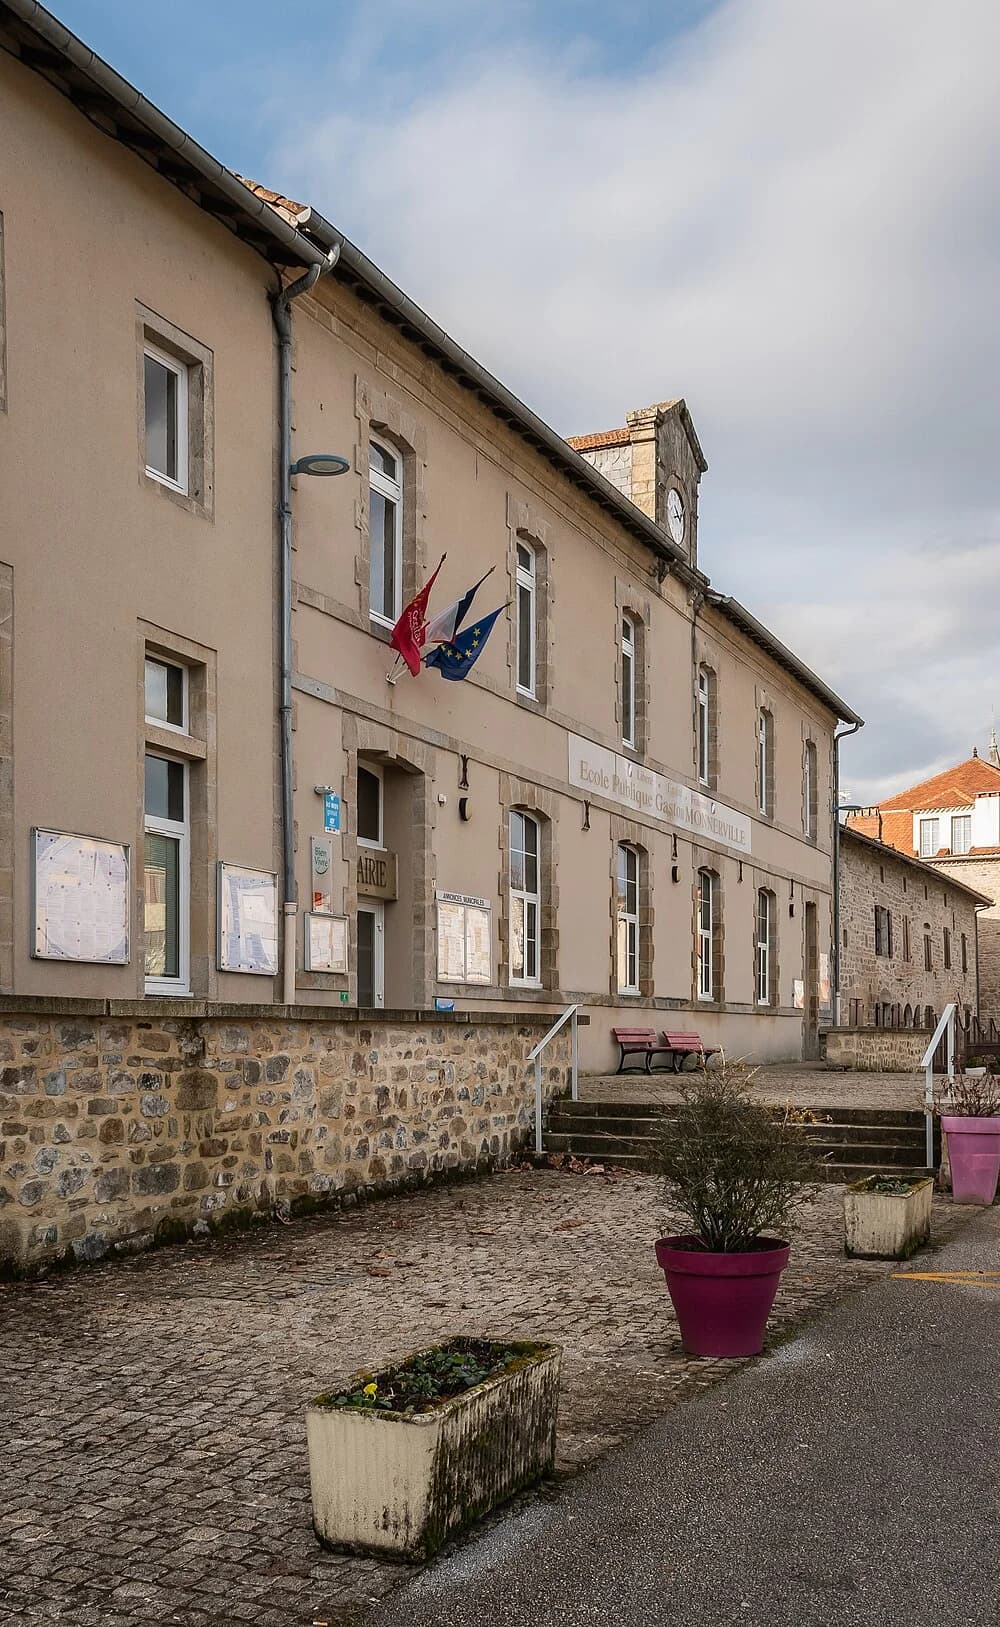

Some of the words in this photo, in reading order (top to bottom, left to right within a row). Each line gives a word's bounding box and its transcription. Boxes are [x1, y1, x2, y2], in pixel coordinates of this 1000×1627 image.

[580, 760, 609, 789] Ecole
[612, 774, 653, 808] Publique
[656, 793, 684, 818] Gaston
[685, 805, 746, 845] MONNERVILLE
[357, 855, 387, 888] AIRIE
